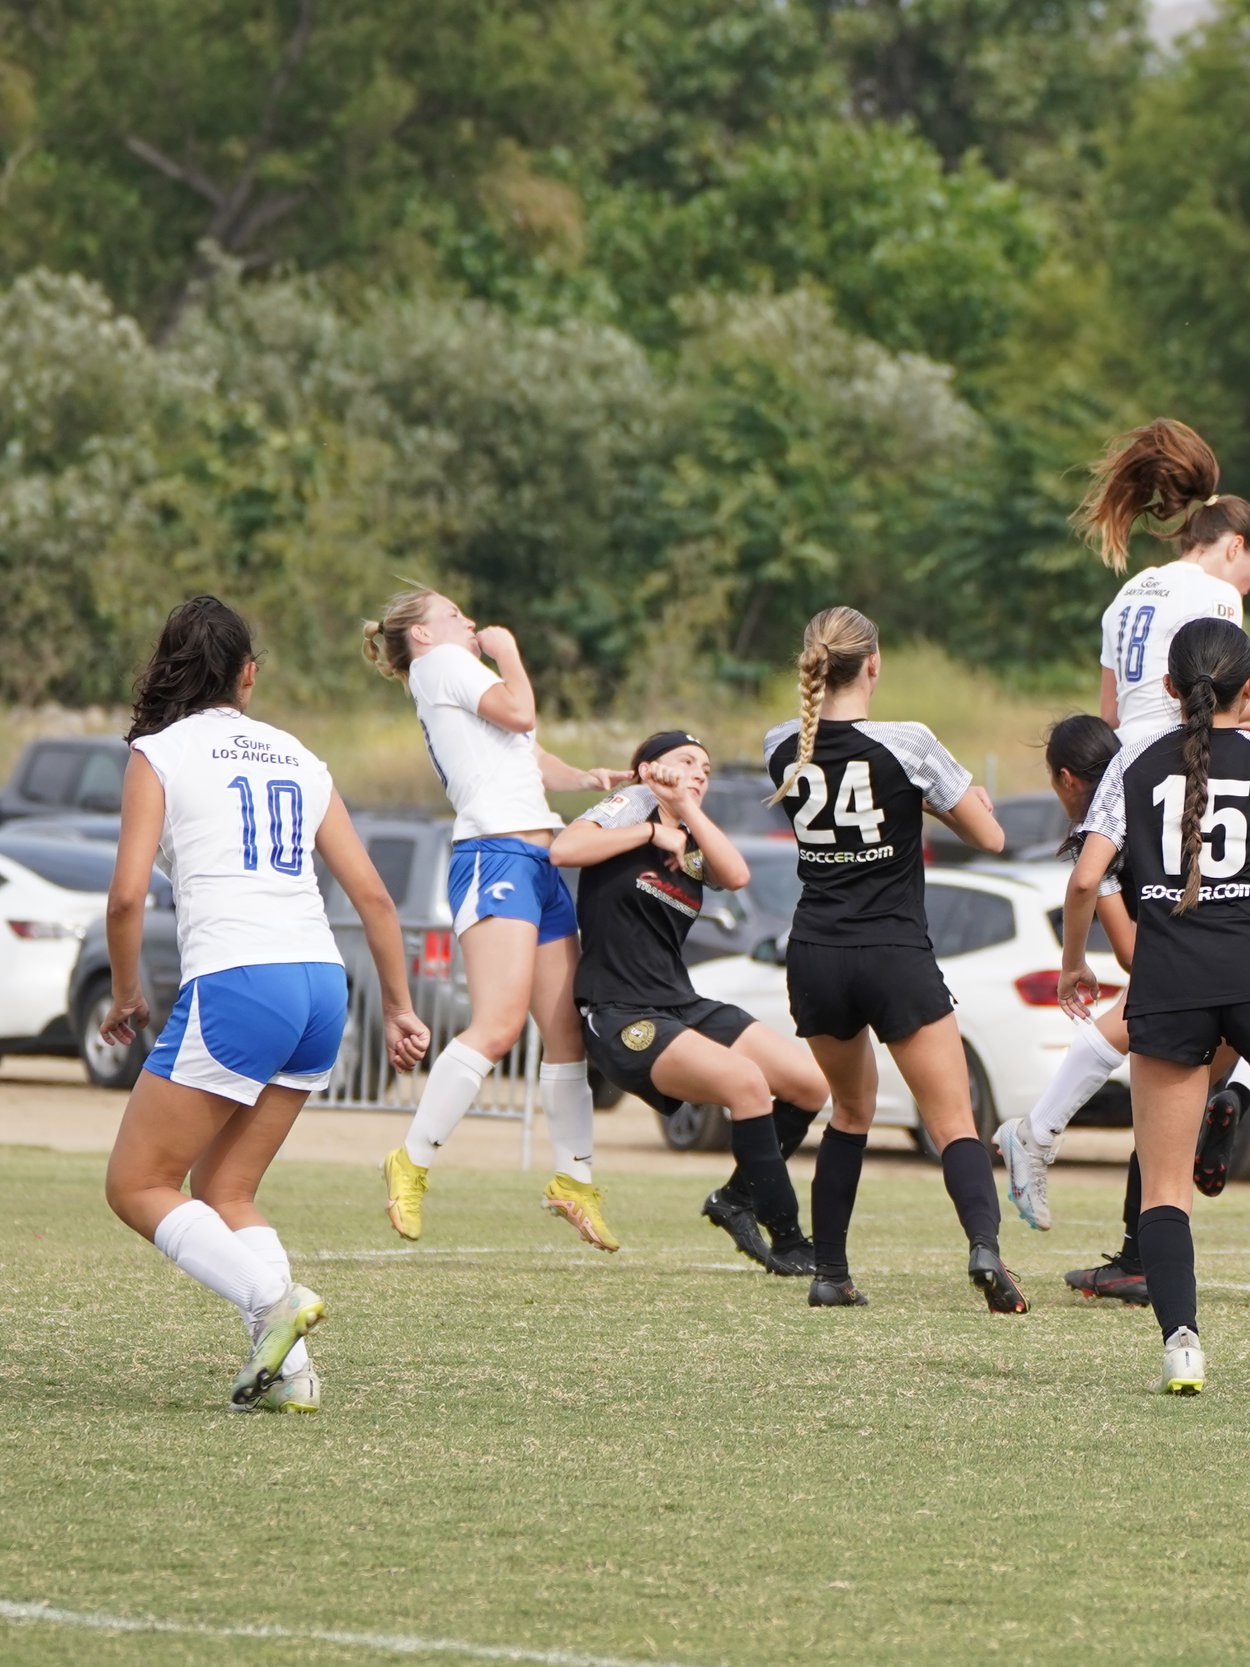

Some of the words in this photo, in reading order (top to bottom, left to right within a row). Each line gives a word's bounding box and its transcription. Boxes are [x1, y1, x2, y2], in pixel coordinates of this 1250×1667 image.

[1117, 605, 1156, 683] 18
[212, 748, 238, 760] LOS
[241, 750, 299, 767] ANGELES
[234, 736, 272, 751] SURF
[226, 775, 304, 877] 10
[783, 760, 886, 845] 24
[1152, 774, 1250, 879] 15
